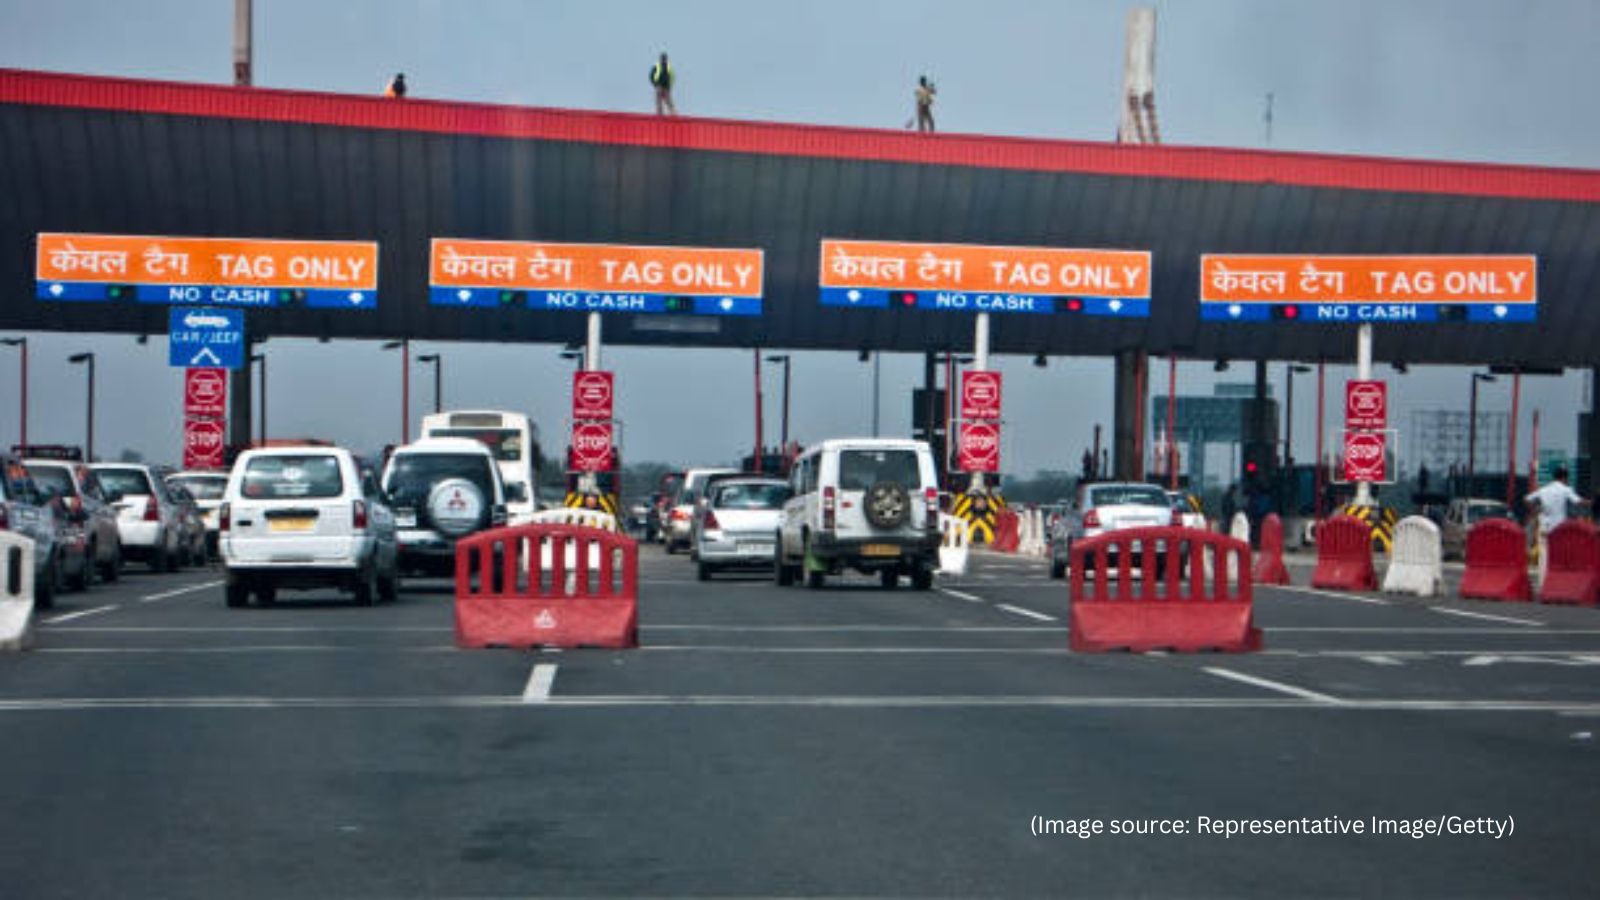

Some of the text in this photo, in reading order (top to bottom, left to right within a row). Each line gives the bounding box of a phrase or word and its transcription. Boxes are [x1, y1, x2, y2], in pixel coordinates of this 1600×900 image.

[49, 242, 127, 273] केवल
[217, 254, 365, 280] TAG ONLY
[440, 246, 516, 278] केवल
[832, 247, 905, 280] केवल
[602, 261, 753, 287] TAG ONLY
[990, 261, 1142, 288] TAG ONLY
[1212, 262, 1286, 293] केवल
[1370, 271, 1527, 294] TAG ONLY
[169, 287, 270, 303] NO CASH
[546, 293, 645, 309] NO CASH
[936, 293, 1034, 309] NO CASH
[1318, 305, 1417, 319] NO CASH
[190, 434, 219, 446] STOP
[577, 436, 608, 450] STOP
[964, 436, 996, 450] STOP
[1349, 444, 1379, 459] STOP
